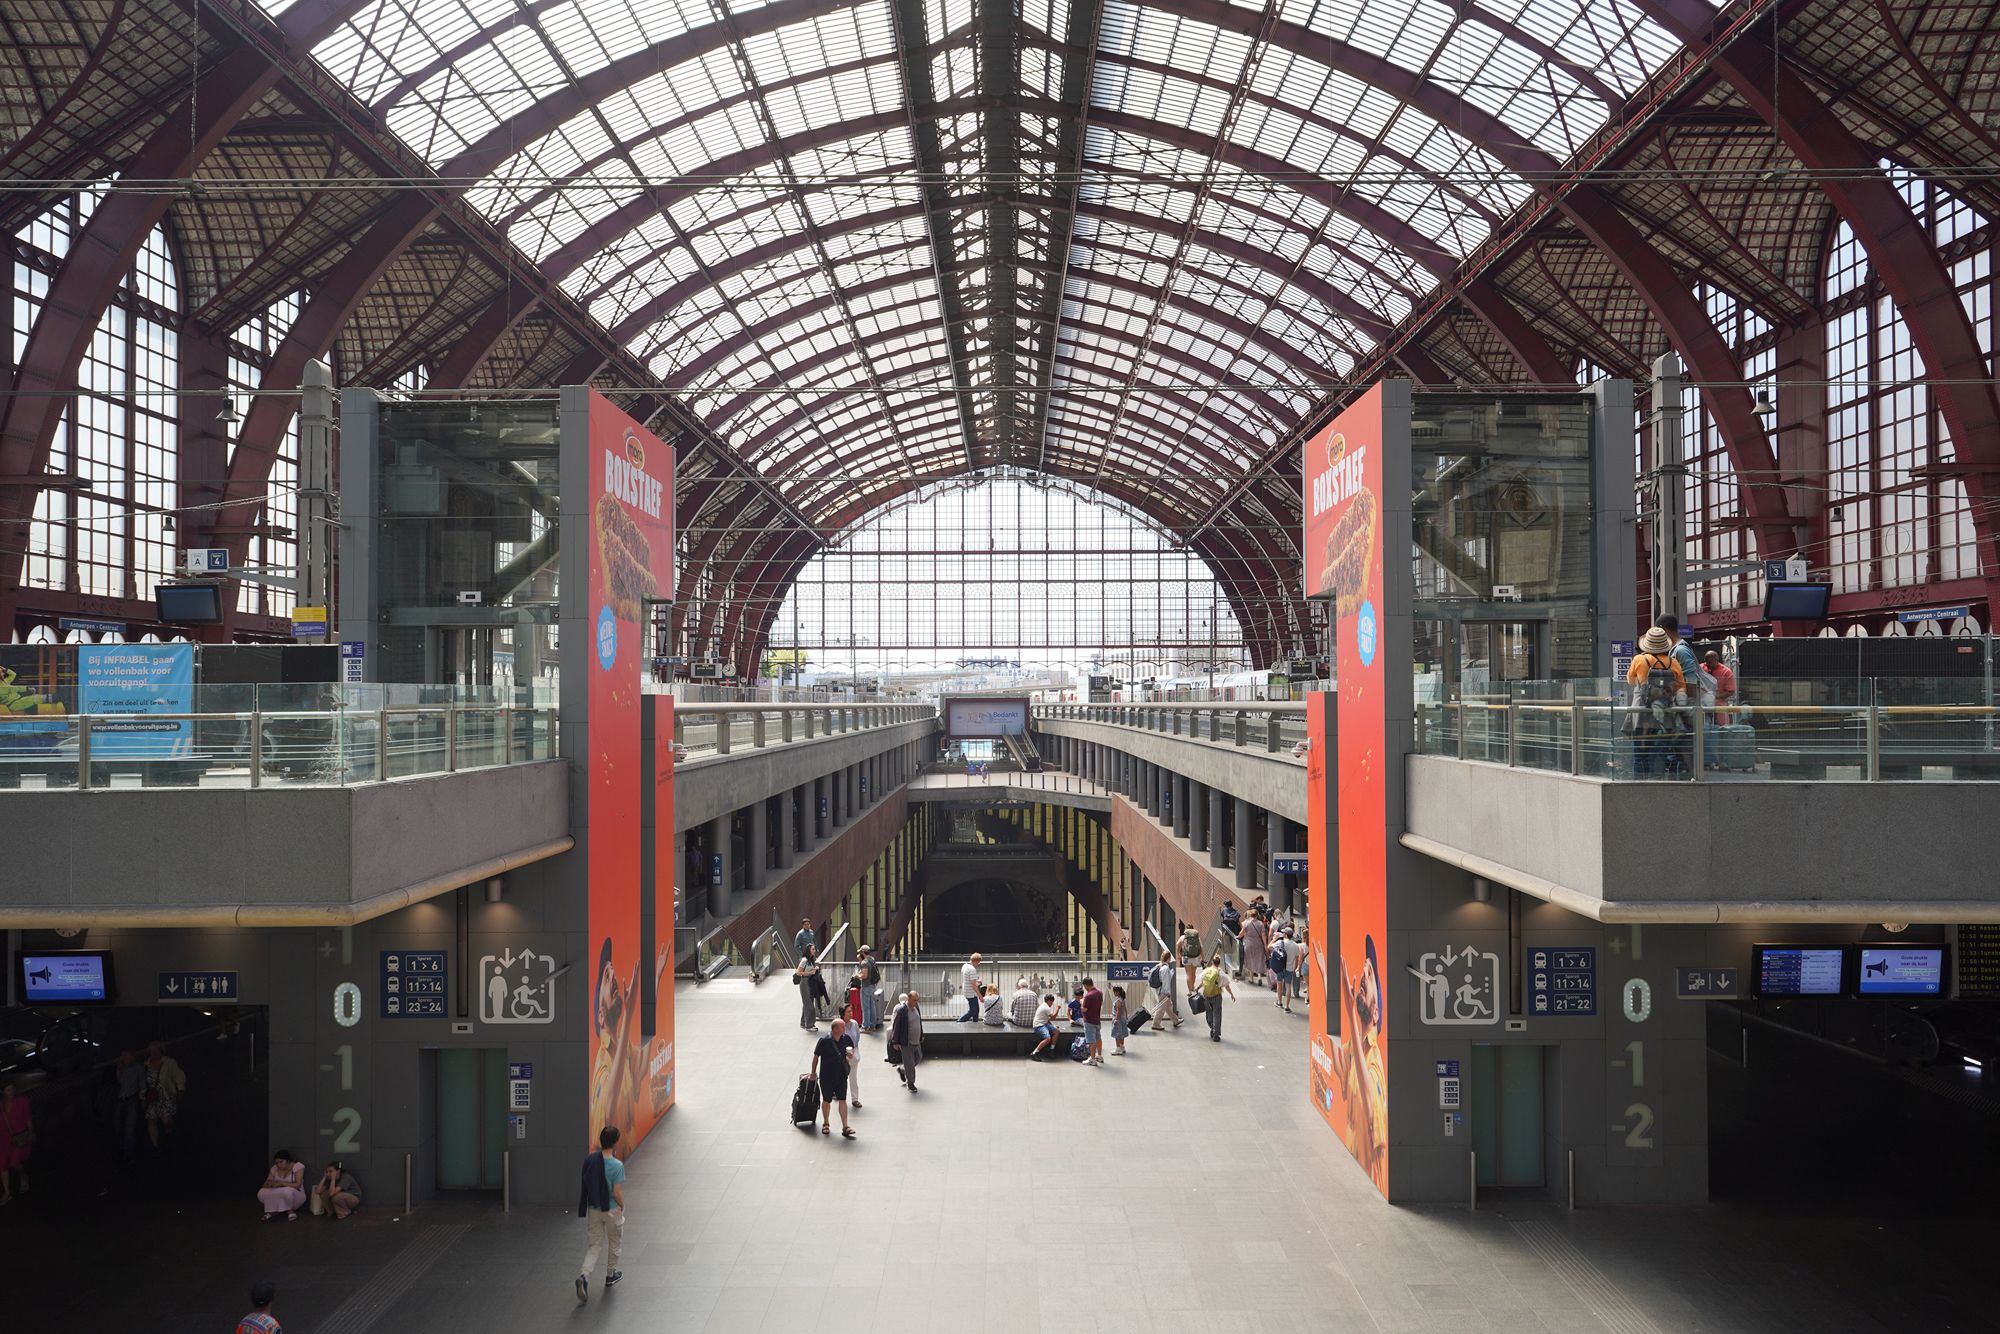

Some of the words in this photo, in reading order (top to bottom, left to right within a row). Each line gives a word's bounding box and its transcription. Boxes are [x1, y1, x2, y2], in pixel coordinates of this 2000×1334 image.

[70, 622, 95, 630] Antwerpen
[88, 656, 100, 665] Bij
[152, 656, 176, 666] gaan
[103, 666, 148, 675] vollenbak
[88, 678, 147, 688] vooruitgang!
[411, 961, 416, 970] 1
[432, 961, 438, 970] 6
[1559, 958, 1564, 967] 1
[1580, 958, 1586, 967] 6
[334, 982, 362, 1027] 0
[1623, 978, 1651, 1023] 0
[320, 1044, 352, 1090] -1
[1610, 1040, 1644, 1087] -1
[320, 1107, 362, 1153] -2
[1611, 1103, 1654, 1150] -2
